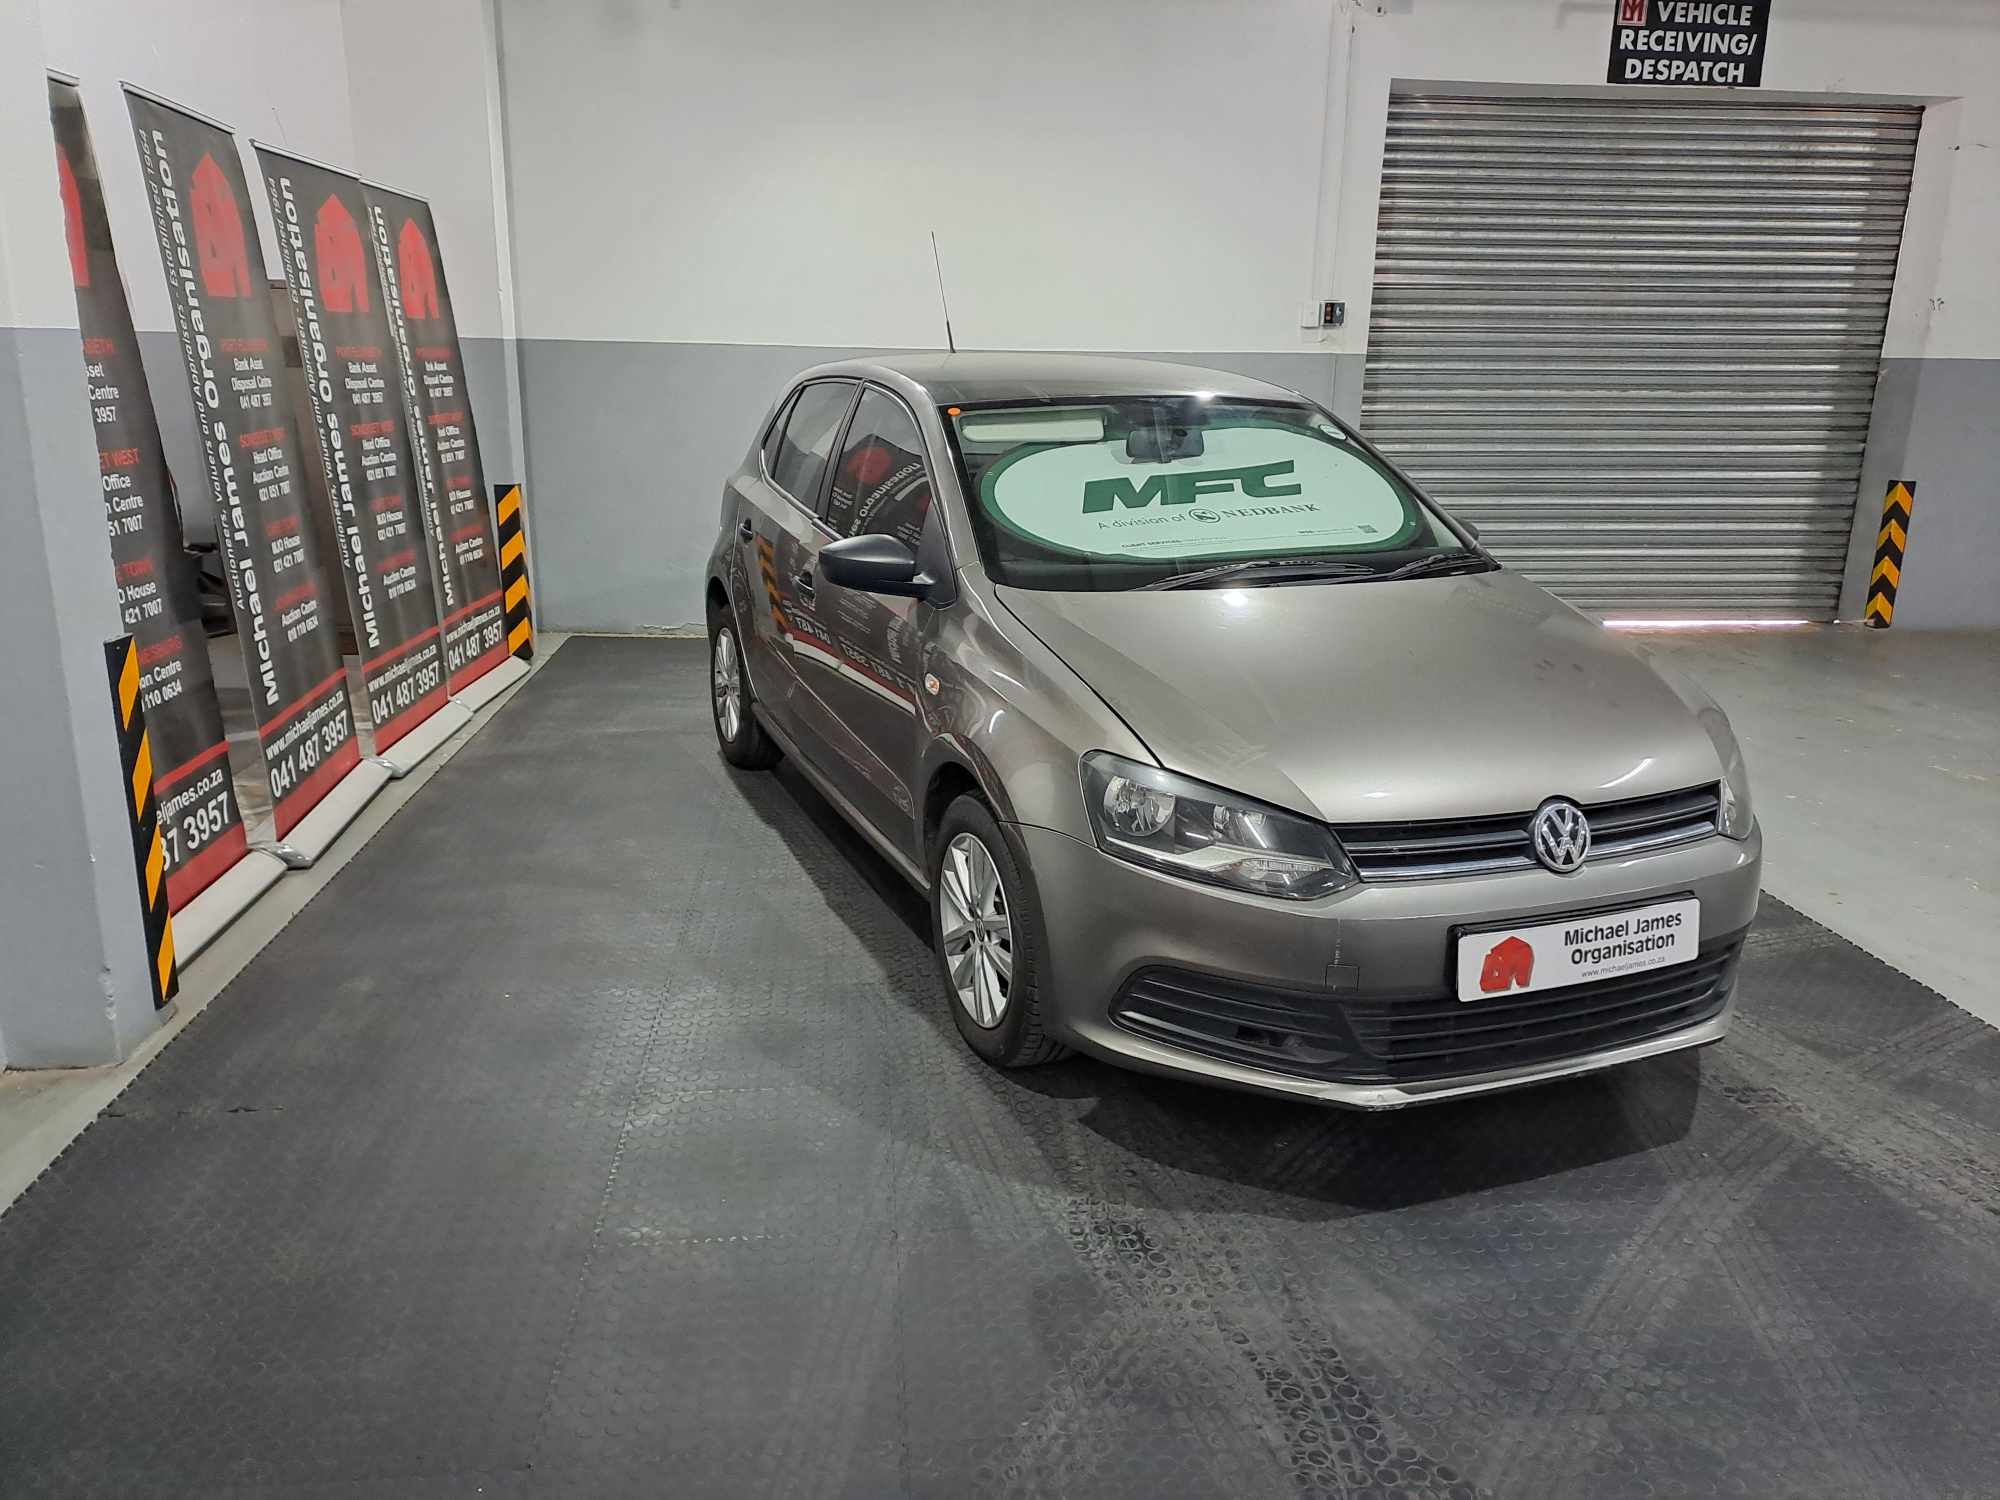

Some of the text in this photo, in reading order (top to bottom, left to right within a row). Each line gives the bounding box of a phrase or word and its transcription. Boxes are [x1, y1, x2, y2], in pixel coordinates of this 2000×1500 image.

[1658, 1, 1753, 26] VEHICLE
[1619, 29, 1757, 55] RECEIVING/
[1625, 58, 1745, 83] DESPATCH
[139, 128, 155, 175] 1964
[149, 179, 178, 287] Established
[374, 206, 416, 396] Organisation
[177, 303, 201, 397] Appraisers
[88, 384, 119, 400] Centre
[312, 395, 323, 424] and
[95, 406, 117, 422] 3957
[152, 130, 279, 706] Michael James Organisation
[195, 399, 209, 435] and
[280, 177, 380, 648] Michael James Organisation
[102, 473, 131, 491] Office
[205, 439, 222, 502] Valuers
[1082, 459, 1302, 514] MFC
[113, 495, 144, 513] Centre
[1098, 504, 1320, 530] A division of NEDBANK
[122, 515, 143, 532] 7007
[220, 509, 246, 610] Auctioneers,
[430, 501, 454, 606] Michael
[127, 581, 157, 599] House
[125, 598, 163, 624] 421 7007
[448, 620, 502, 671] 041 487 3957
[154, 659, 182, 682] Centre
[163, 679, 183, 701] 0634
[372, 660, 439, 724] 041 487 3957
[270, 709, 348, 798] 041 487 3957
[156, 767, 223, 826] eljames.co.za
[183, 791, 231, 850] 3957
[1564, 912, 1682, 946] Michael James
[1571, 933, 1675, 964] Organisation
